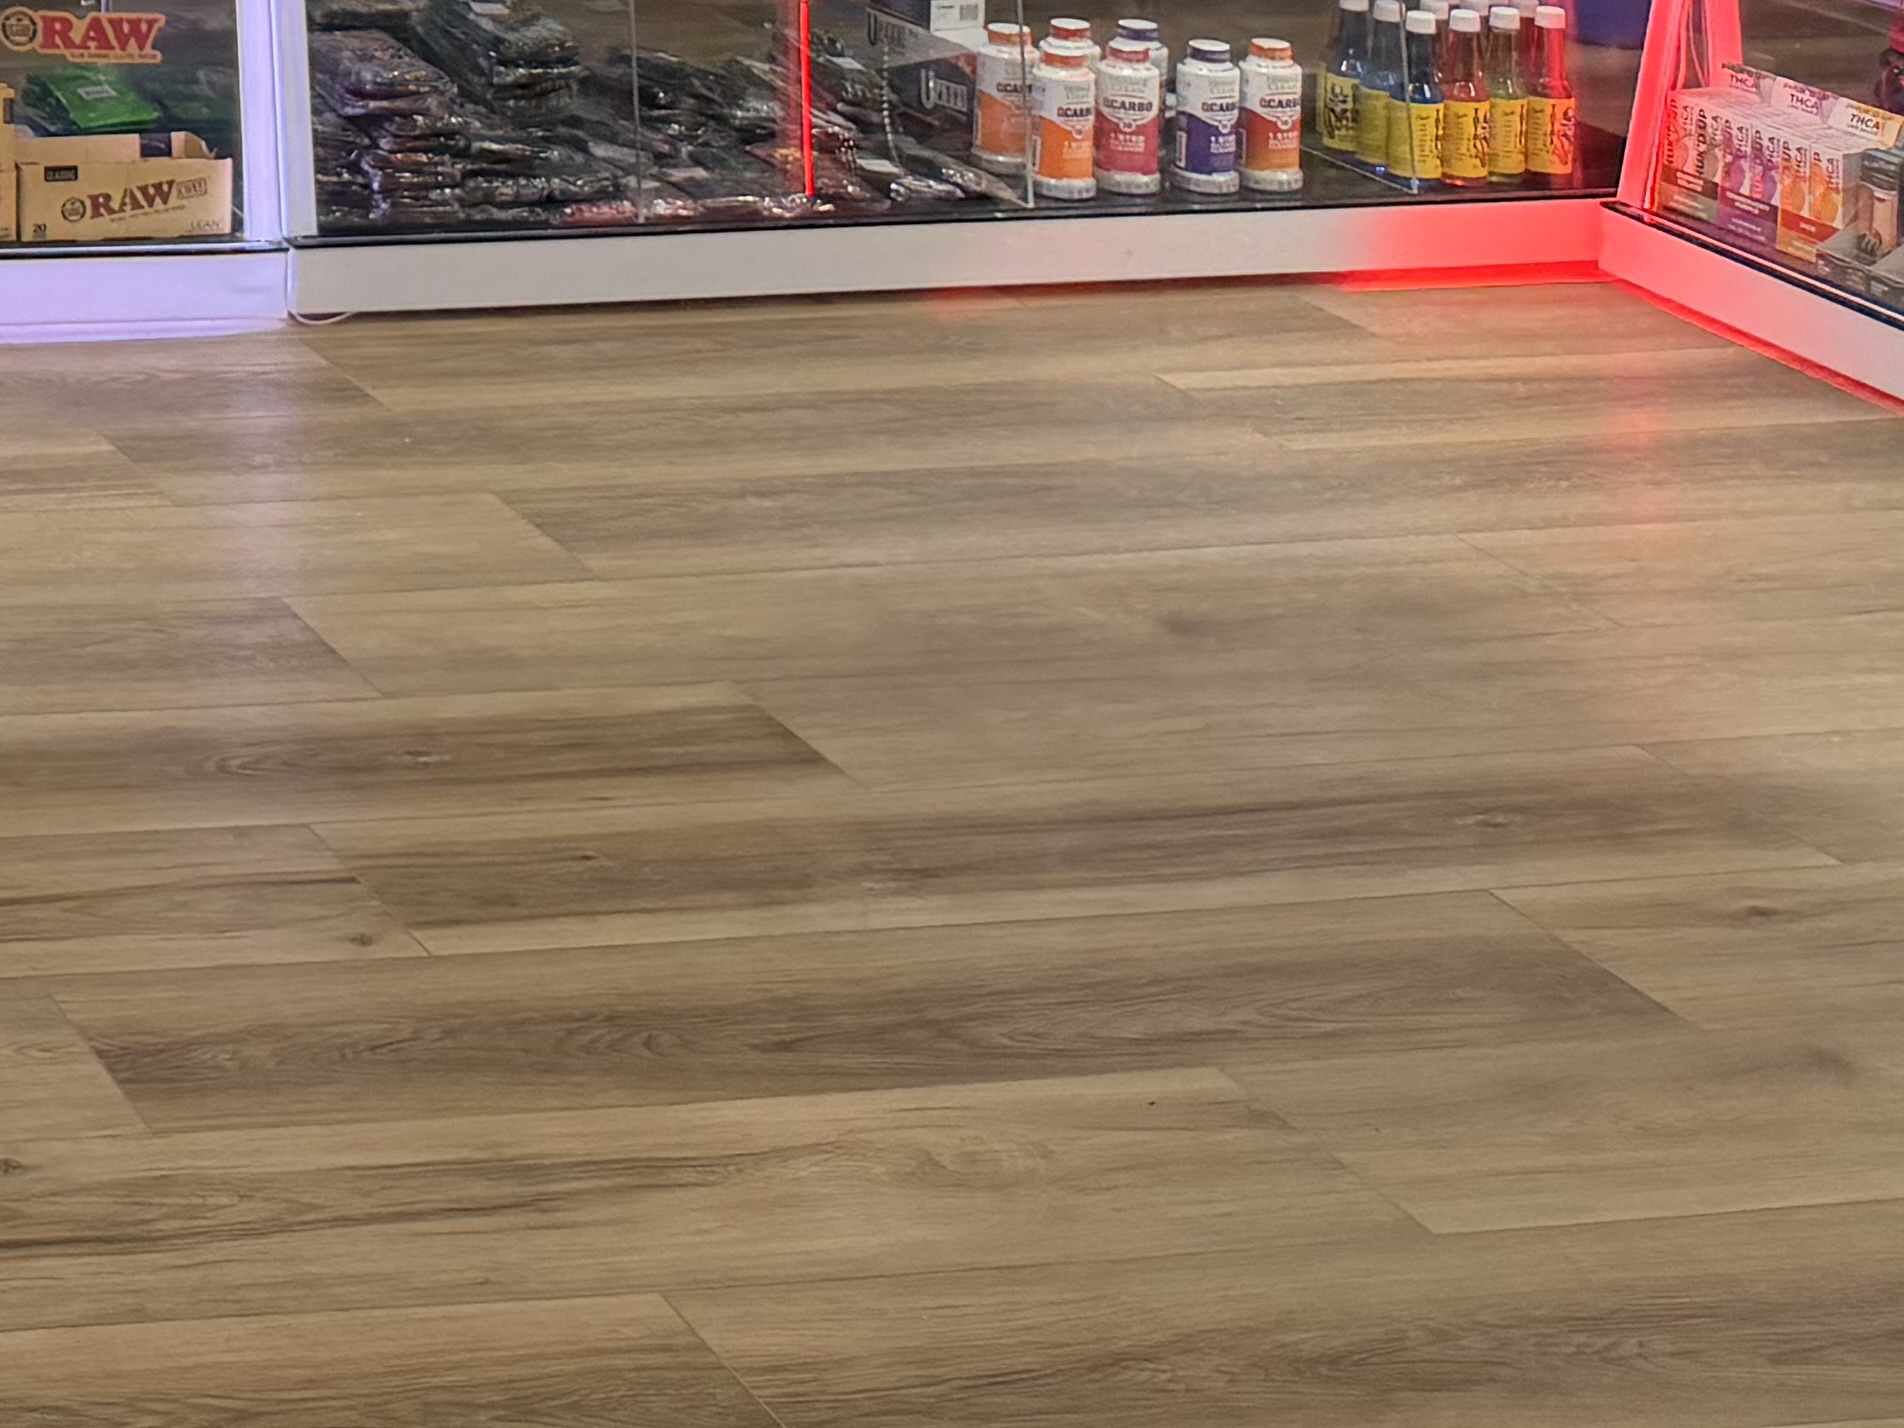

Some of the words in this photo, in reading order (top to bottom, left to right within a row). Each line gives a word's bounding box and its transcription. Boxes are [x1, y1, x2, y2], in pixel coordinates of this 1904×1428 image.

[38, 15, 160, 52] RAW
[1850, 113, 1882, 131] THCA
[87, 179, 176, 221] RAW
